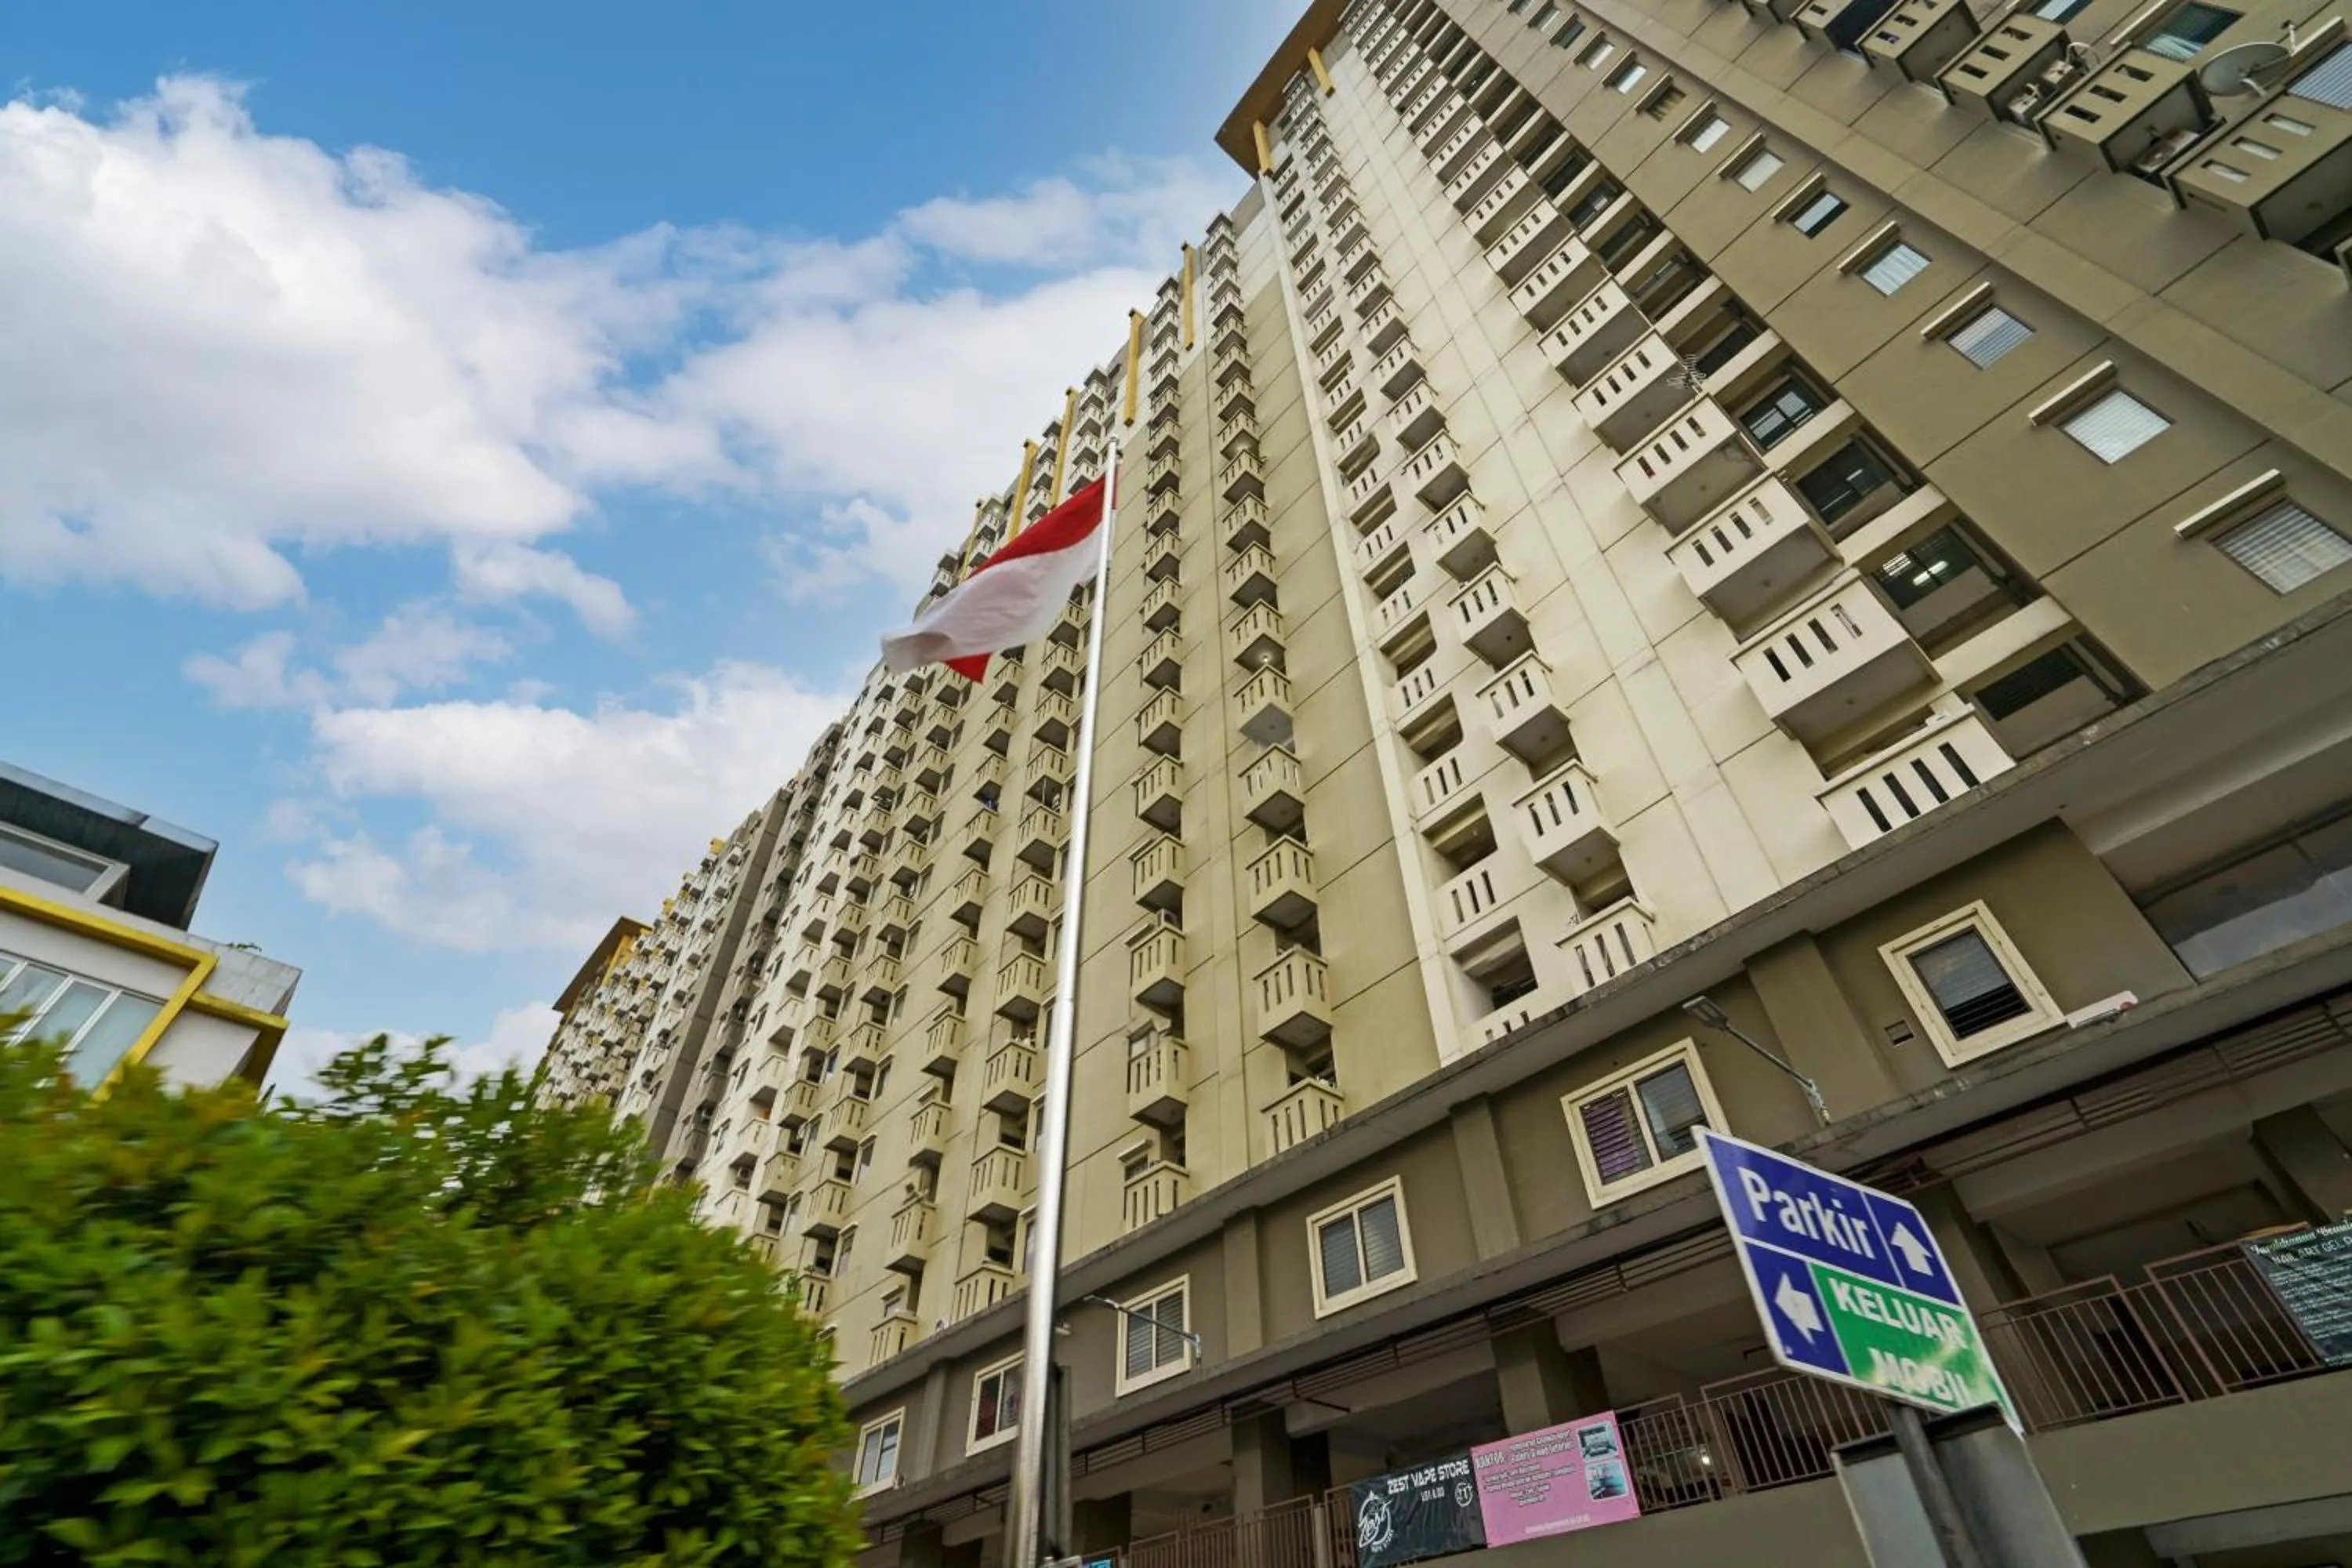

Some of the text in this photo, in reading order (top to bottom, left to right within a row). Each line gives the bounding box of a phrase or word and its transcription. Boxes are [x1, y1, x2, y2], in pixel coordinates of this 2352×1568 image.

[1736, 1166, 1876, 1260] Parkir
[1828, 1277, 1969, 1350] KELUAR
[1387, 1474, 1409, 1495] ZEST
[1410, 1467, 1437, 1488] VAPE
[1437, 1459, 1470, 1481] STORE
